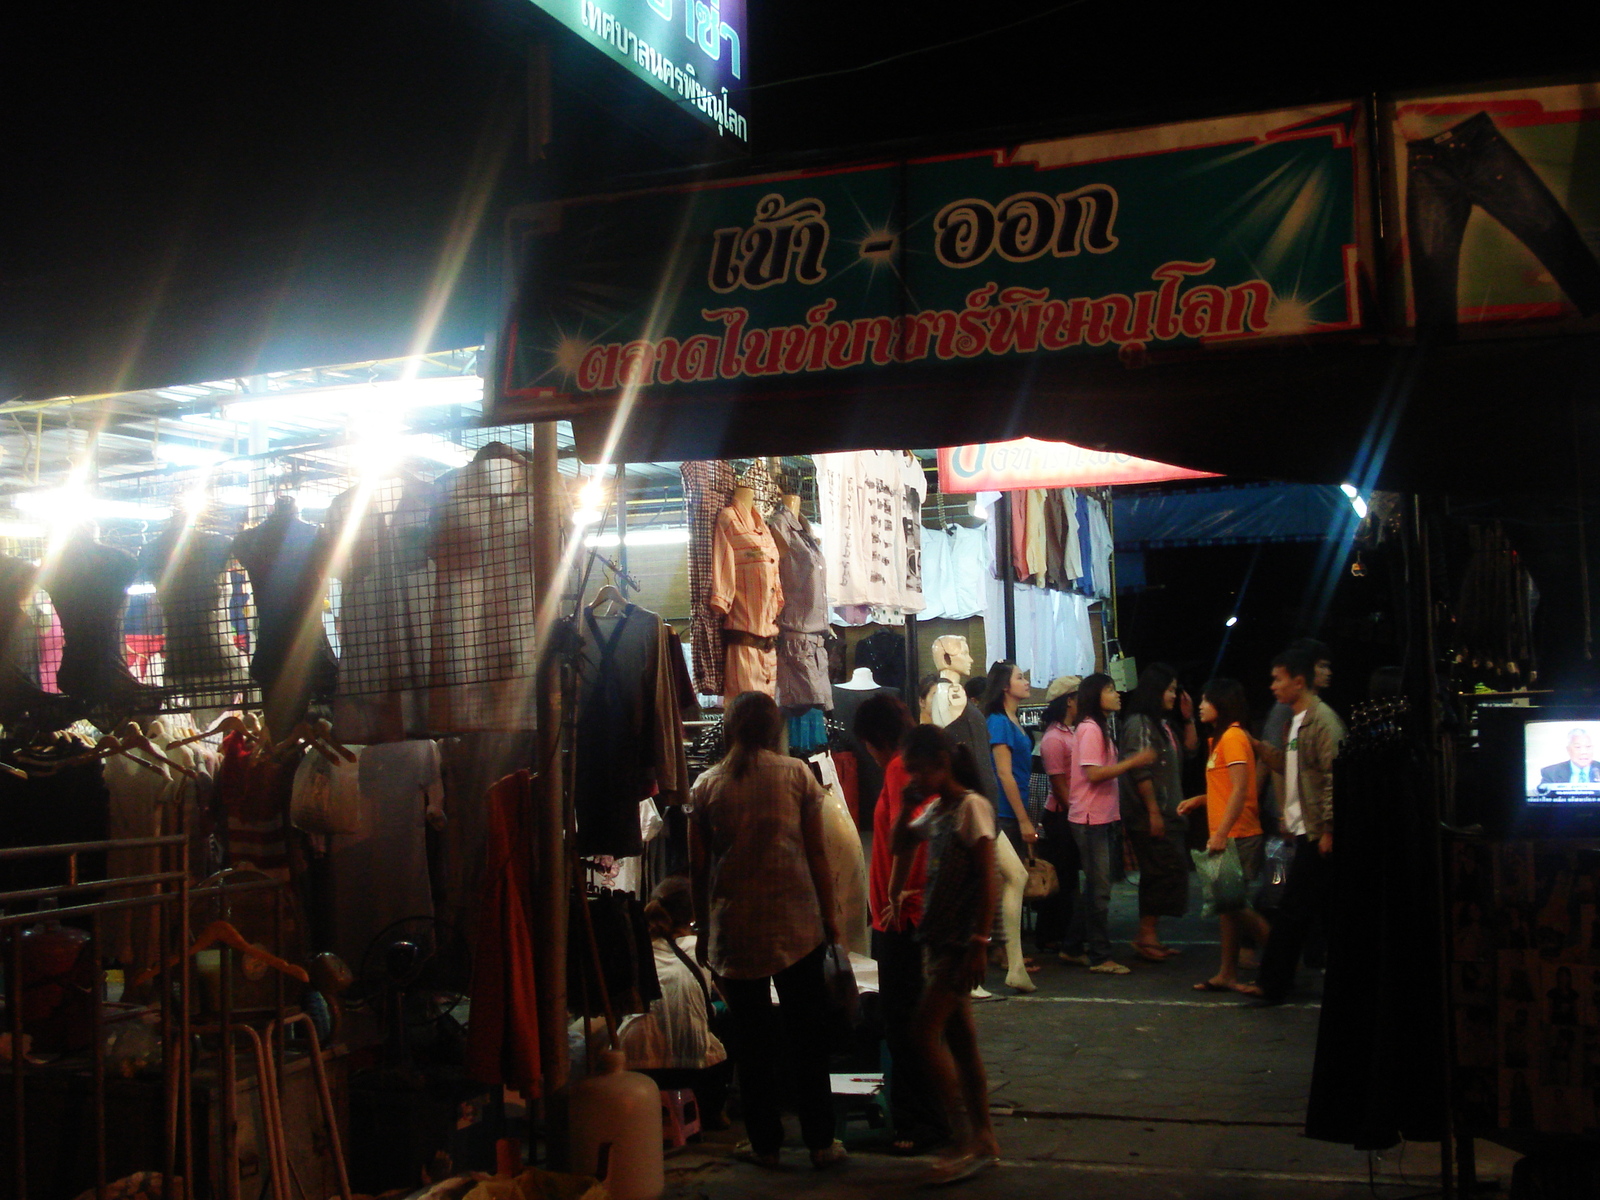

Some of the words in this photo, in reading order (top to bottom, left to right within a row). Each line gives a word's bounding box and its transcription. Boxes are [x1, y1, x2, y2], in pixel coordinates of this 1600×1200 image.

[582, 0, 748, 142] เทศบาลนครพิษณุโลก
[708, 193, 830, 293] เข้า
[933, 183, 1119, 269] ออก
